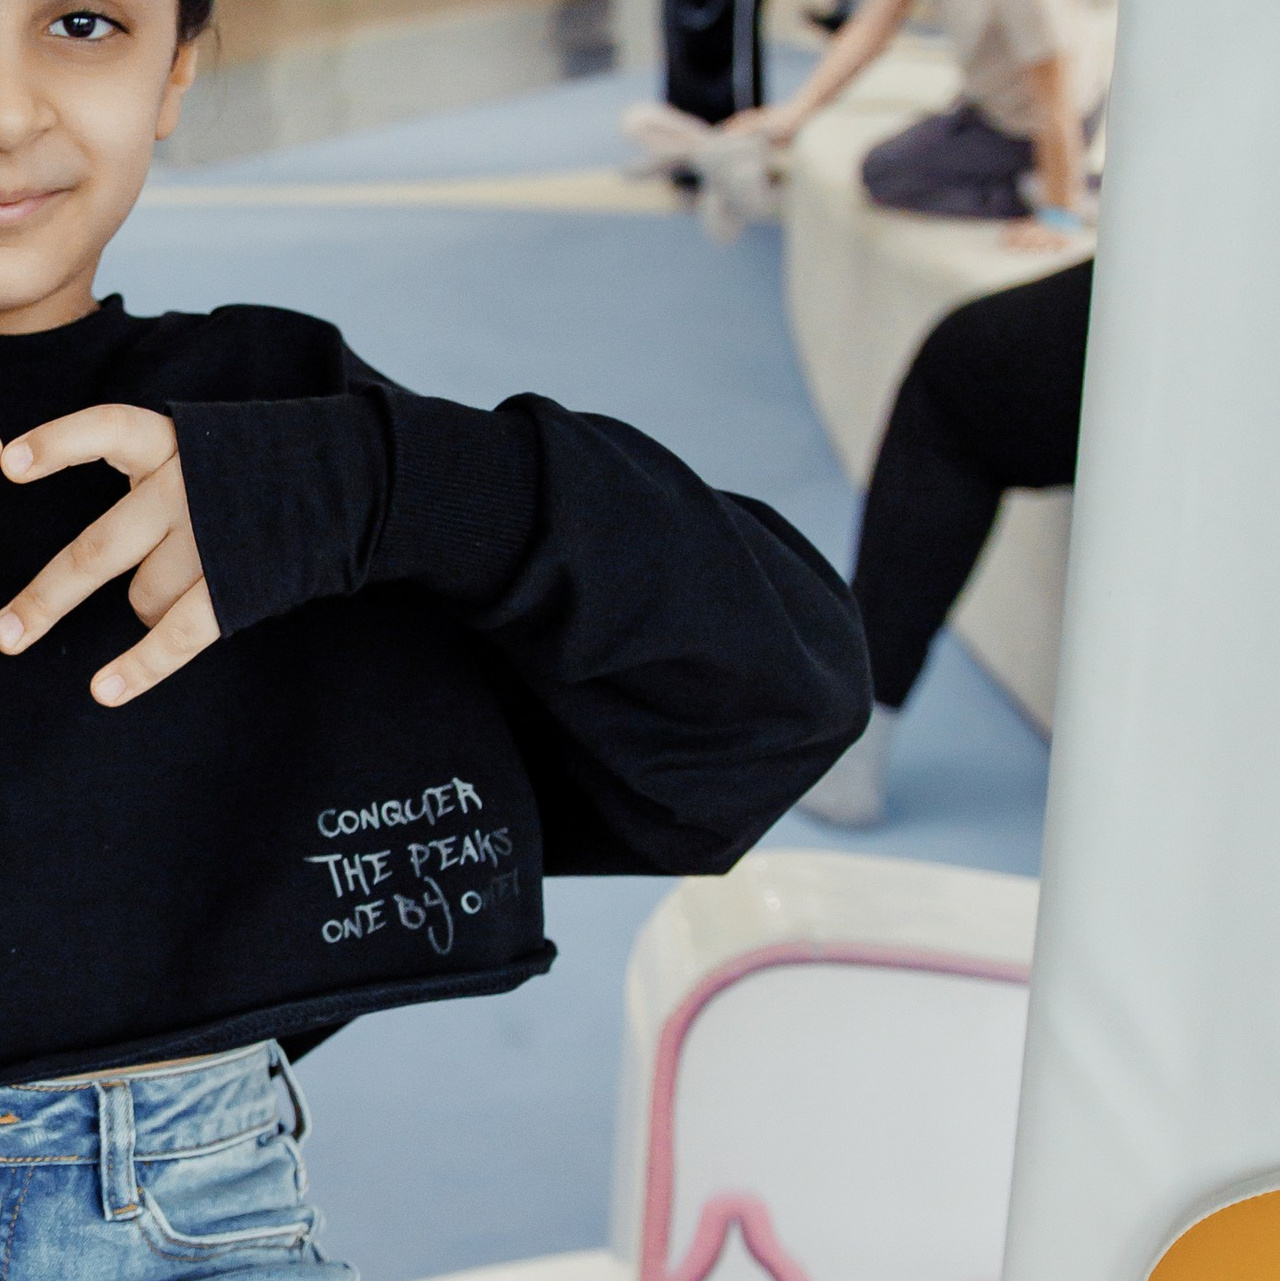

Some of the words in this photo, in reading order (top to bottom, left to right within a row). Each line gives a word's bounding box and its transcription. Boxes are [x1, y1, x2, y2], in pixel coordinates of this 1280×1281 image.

[317, 776, 483, 838] CONQUER
[303, 849, 393, 898] THE
[407, 827, 513, 879] PEAKS
[321, 899, 387, 944] ONE
